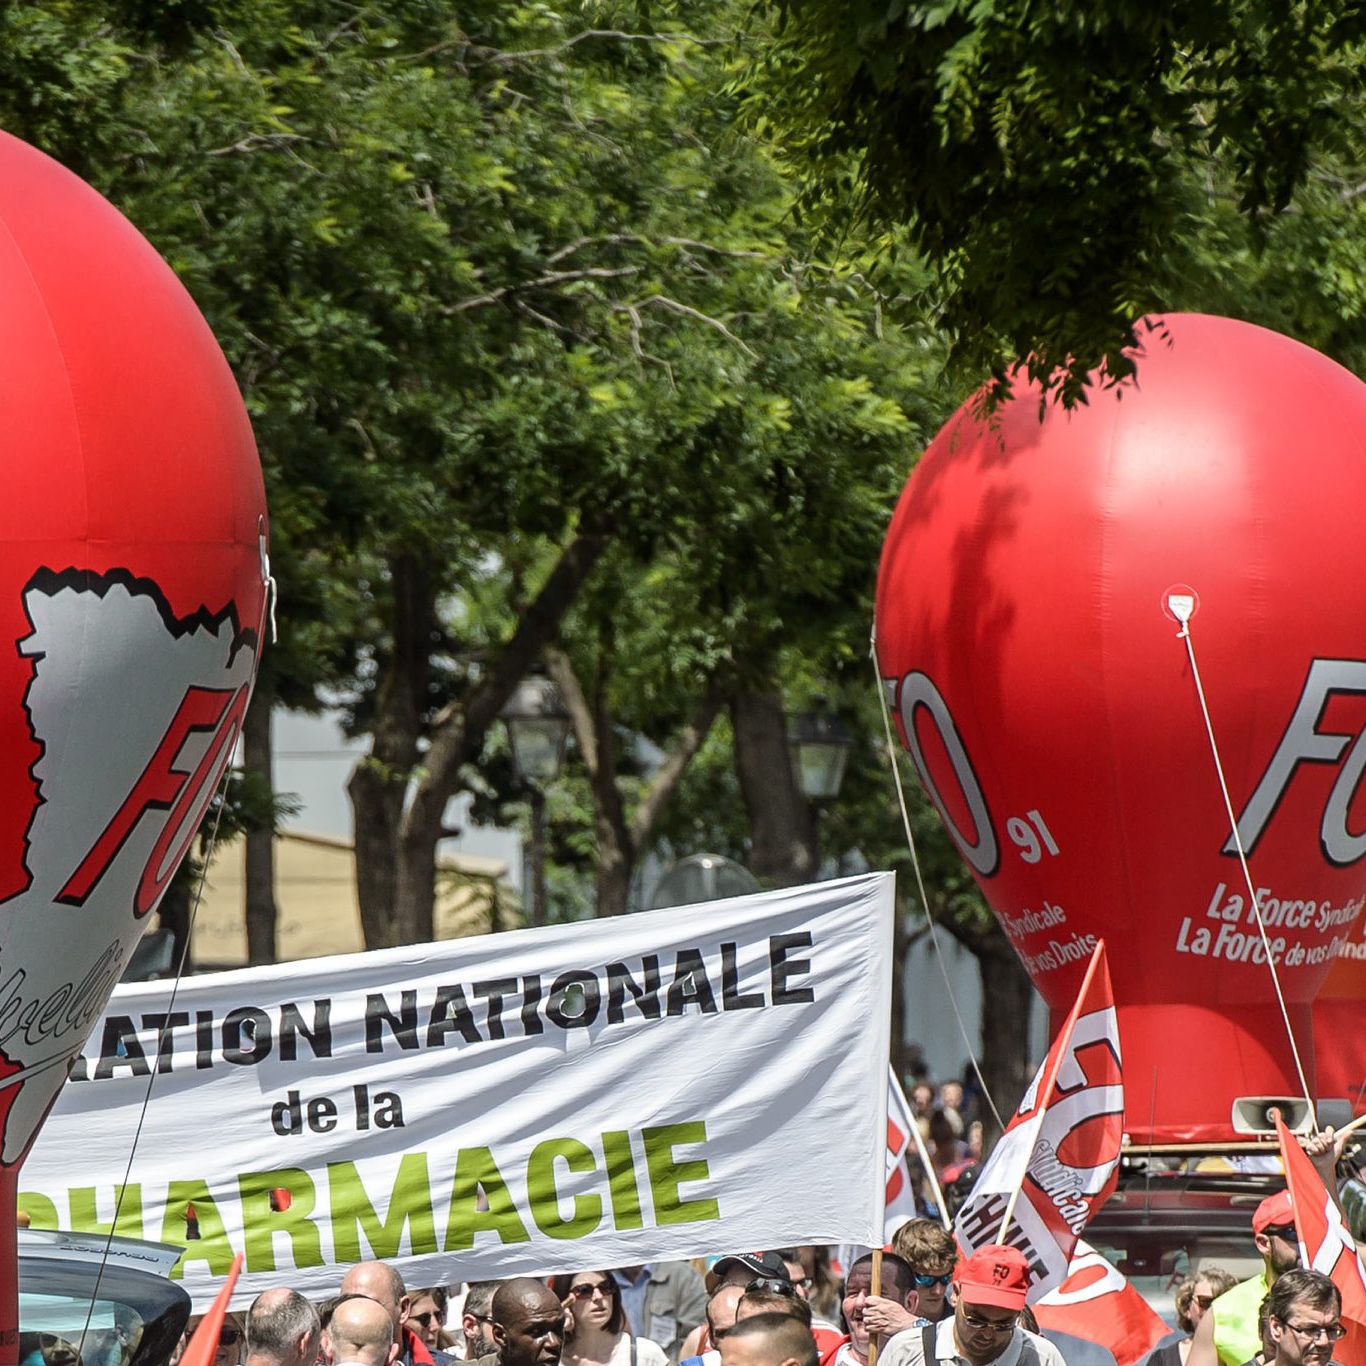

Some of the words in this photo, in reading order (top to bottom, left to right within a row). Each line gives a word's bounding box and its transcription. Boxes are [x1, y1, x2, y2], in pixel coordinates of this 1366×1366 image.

[53, 684, 250, 921] FO
[1006, 809, 1060, 864] 91
[1207, 882, 1241, 920] La
[1251, 888, 1316, 928] Force
[1177, 917, 1211, 955] La
[1212, 923, 1286, 967] Force
[364, 931, 815, 1054] NATIONALE
[271, 1089, 338, 1136] de
[355, 1083, 405, 1131] la
[993, 1264, 1010, 1279] FO
